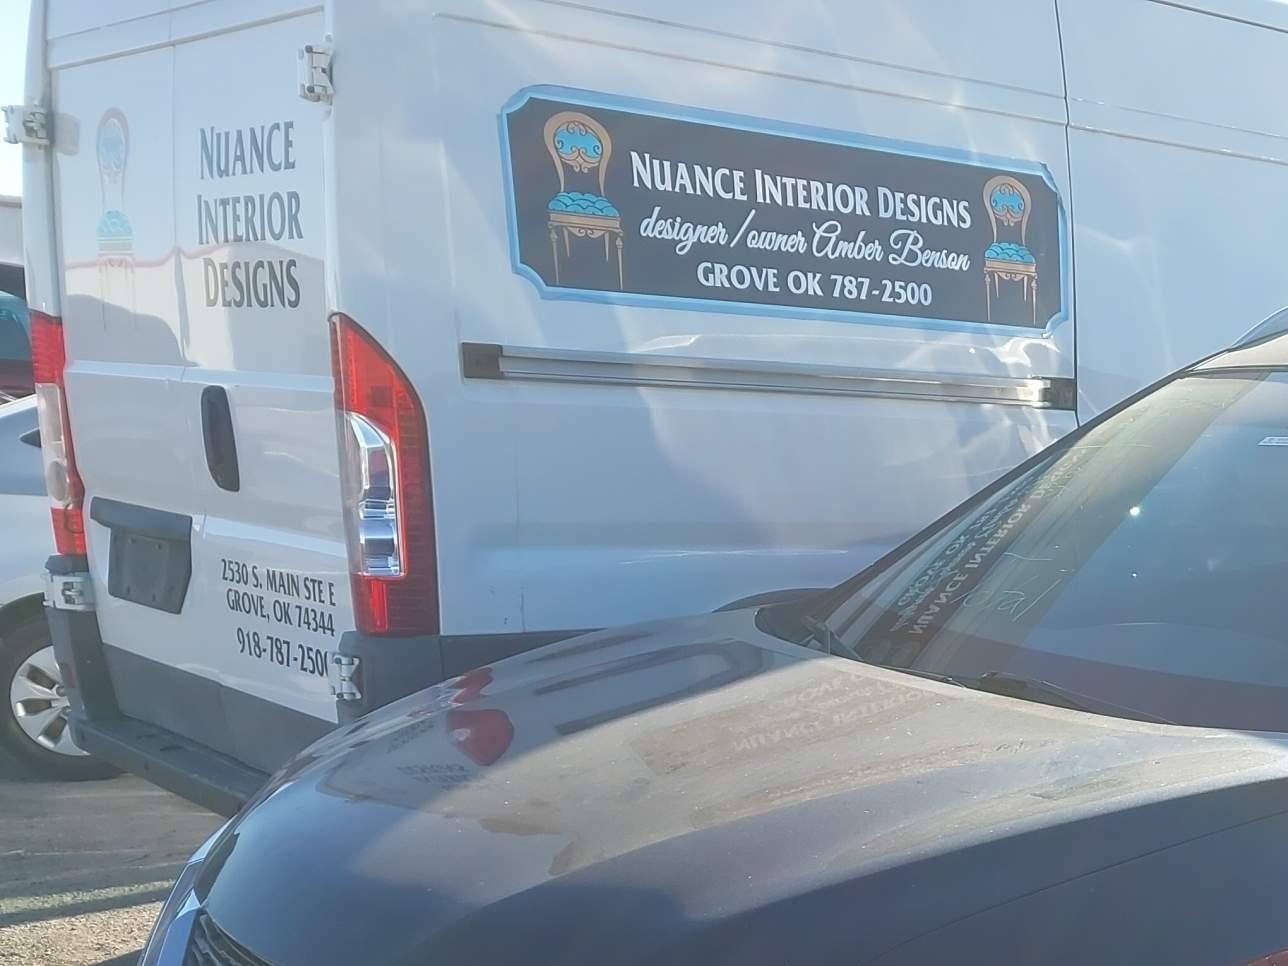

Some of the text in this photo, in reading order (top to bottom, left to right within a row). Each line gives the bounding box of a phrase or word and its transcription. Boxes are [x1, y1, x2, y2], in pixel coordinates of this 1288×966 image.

[199, 121, 296, 180] NUANCE
[630, 151, 972, 229] NUANCE INTERIOR DESIGNS
[197, 190, 304, 245] INTERIOR
[812, 220, 884, 261] Amber
[888, 229, 971, 271] Benson
[203, 257, 300, 309] DESIGNS
[697, 262, 933, 306] GROVE OK 787-2500
[221, 558, 337, 606] 2530 S. MAIN STE E
[226, 588, 335, 637] GROVE, OK 74344
